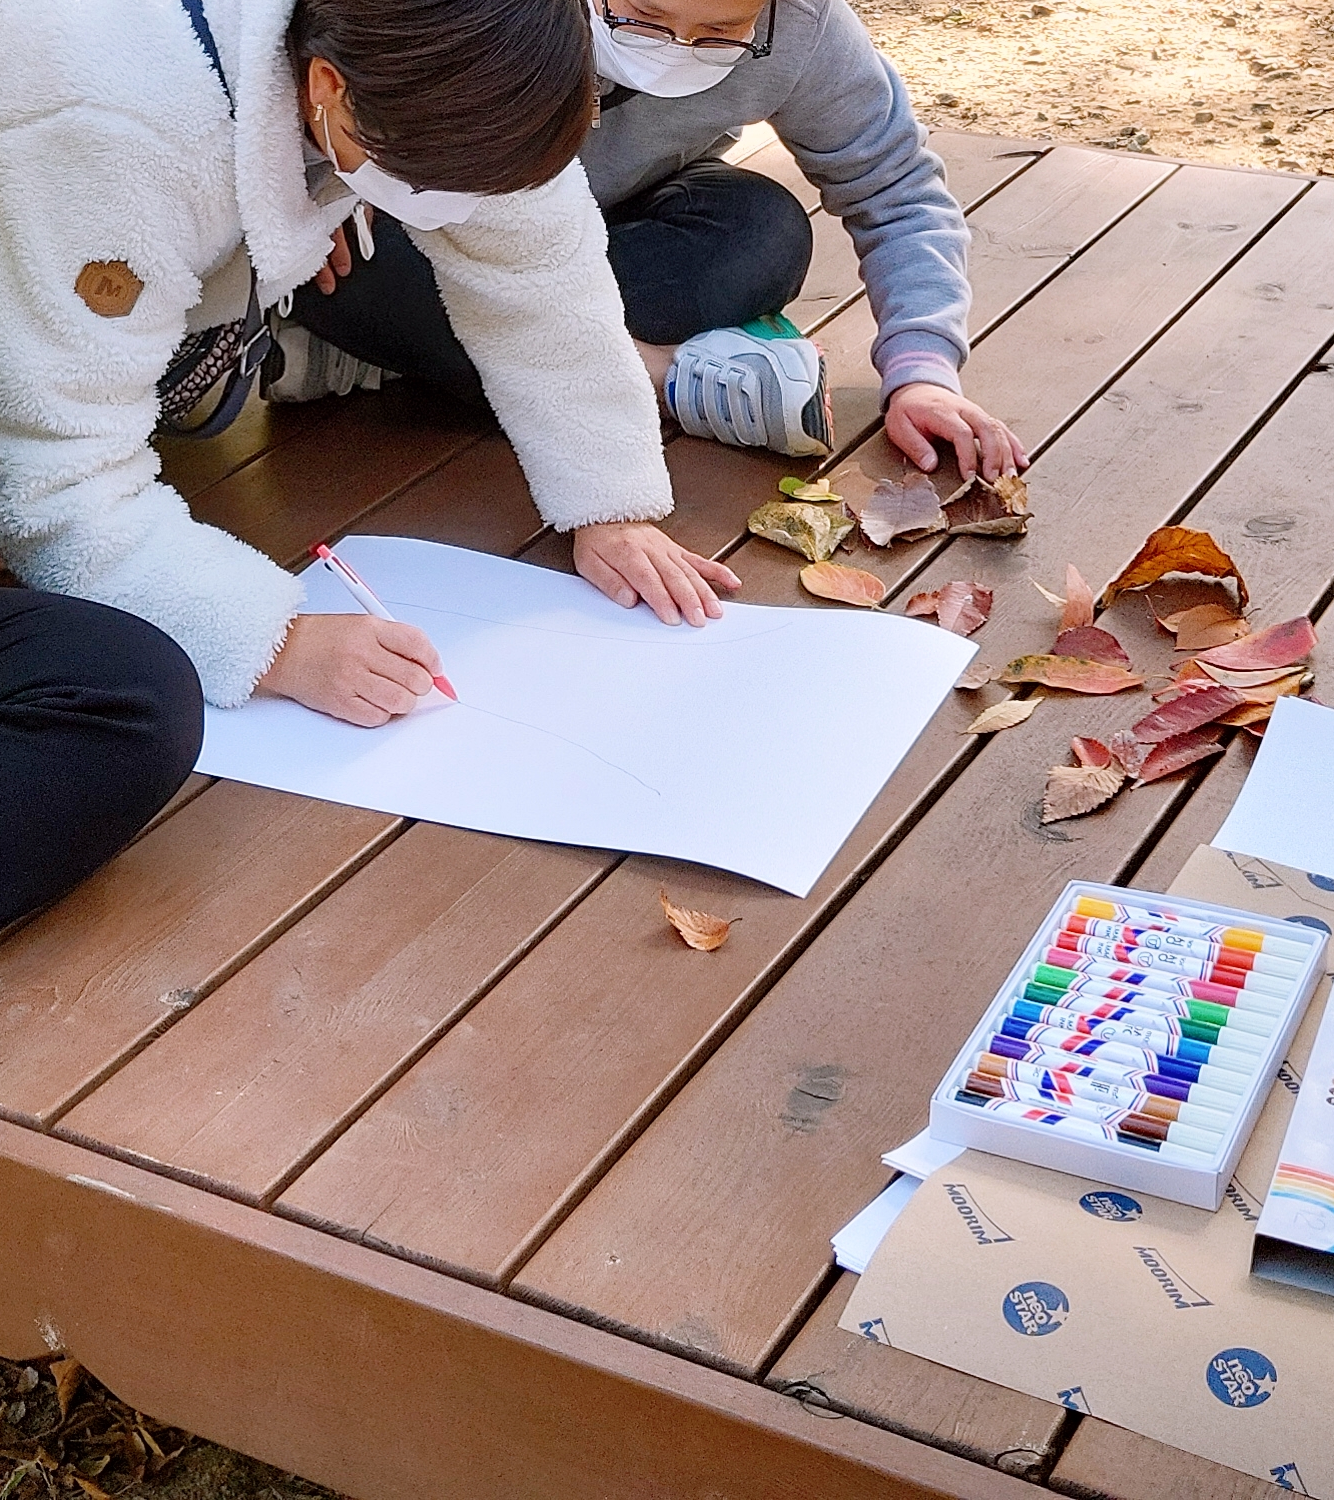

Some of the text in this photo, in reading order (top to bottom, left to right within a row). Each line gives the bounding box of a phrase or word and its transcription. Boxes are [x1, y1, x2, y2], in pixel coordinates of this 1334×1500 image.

[942, 1182, 993, 1246] MOORIM
[1225, 1183, 1260, 1223] ORIM
[1132, 1246, 1192, 1310] MOORIM
[1009, 1290, 1039, 1335] STAR
[1022, 1290, 1049, 1326] neo
[1212, 1358, 1247, 1407] STAR
[1226, 1357, 1255, 1397] neo
